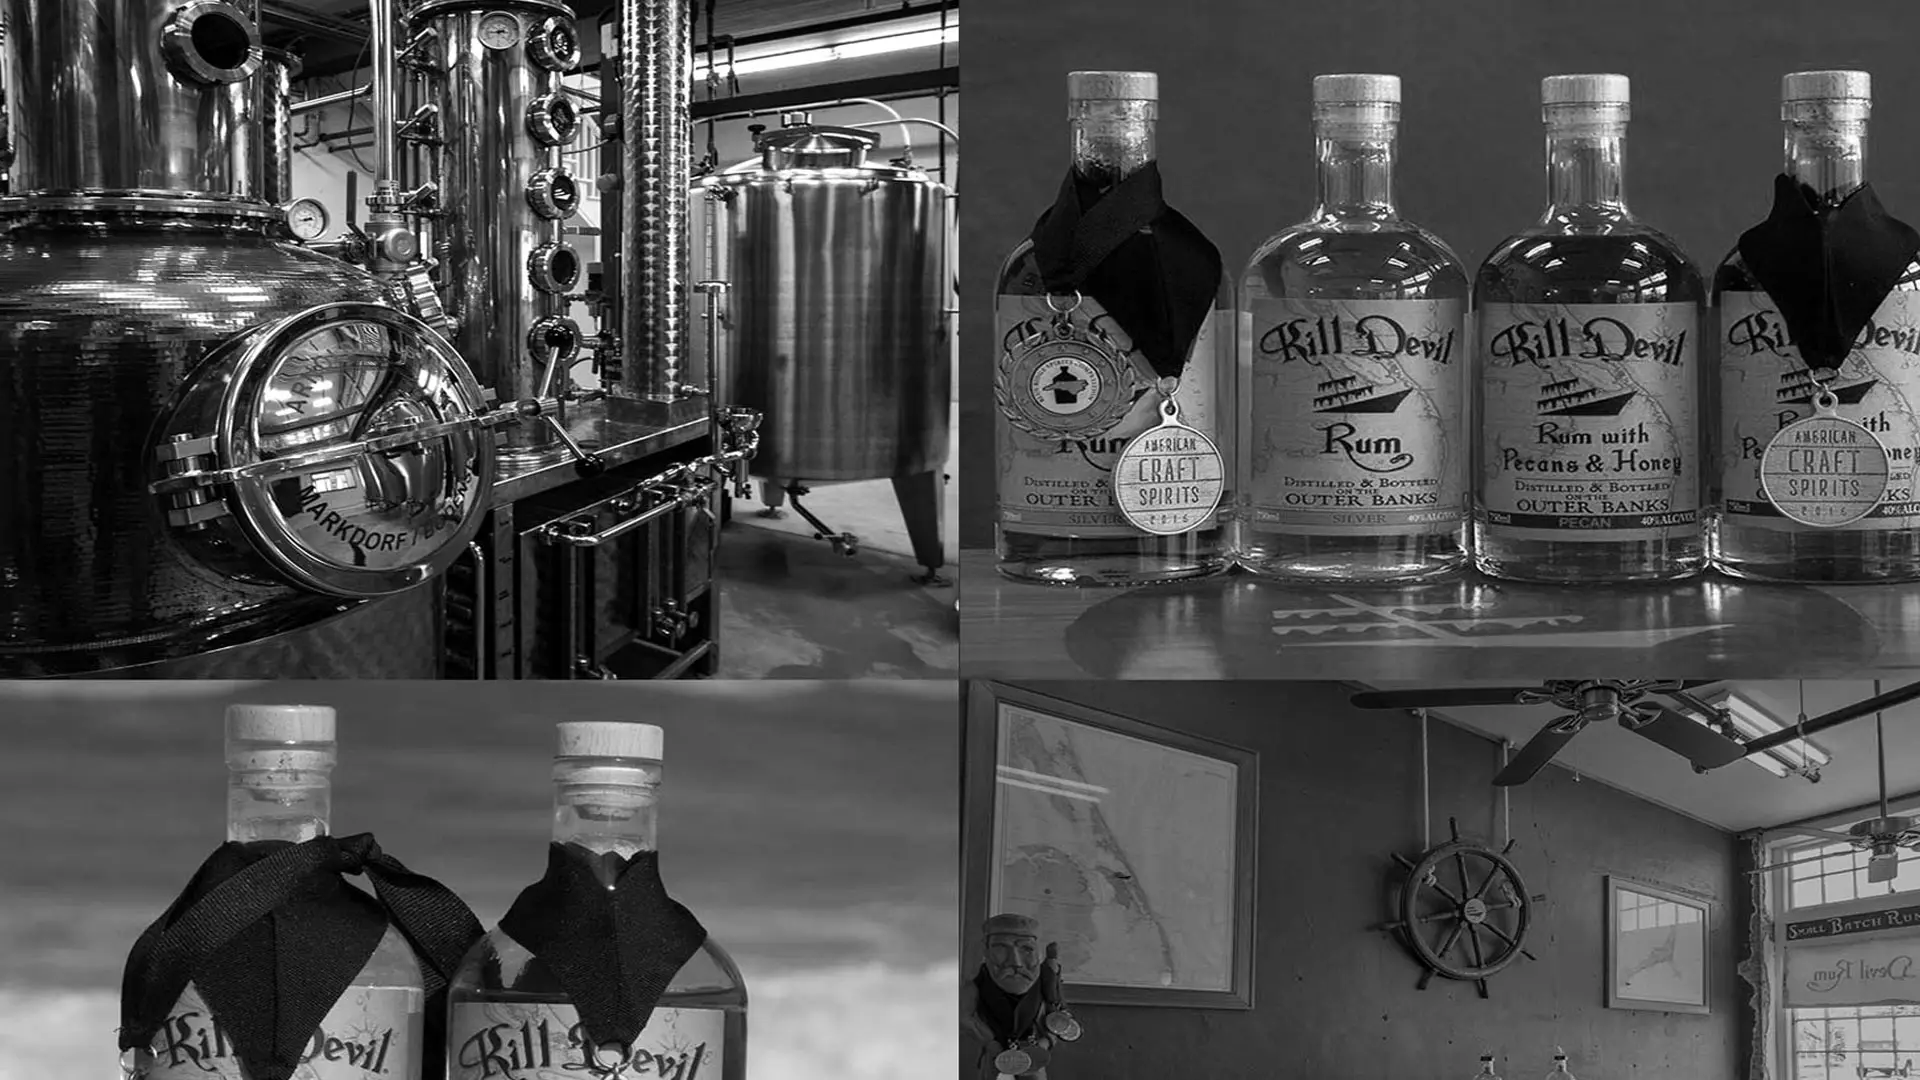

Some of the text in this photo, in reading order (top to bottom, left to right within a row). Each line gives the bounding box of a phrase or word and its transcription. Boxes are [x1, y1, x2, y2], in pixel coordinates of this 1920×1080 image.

[1260, 315, 1454, 366] Kill Devil
[1490, 317, 1687, 369] Kill Devil
[1728, 310, 1790, 357] Ki
[1861, 410, 1890, 432] ith
[1535, 422, 1649, 445] Rum with
[1795, 430, 1856, 444] AMERICAN
[1144, 437, 1197, 453] AMERICAN
[1314, 422, 1414, 473] Rum
[1139, 456, 1200, 483] CRAFT
[1502, 448, 1682, 476] Pecans & Honey
[1788, 450, 1861, 474] CRAFT
[1139, 486, 1200, 505] SPIRITS
[1788, 478, 1860, 497] SPIRITS
[1026, 493, 1100, 507] OUTER
[1285, 492, 1438, 506] OUTER BANKS
[1517, 499, 1670, 514] OUTER BANKS
[299, 485, 407, 551] MARKDORF
[1332, 514, 1387, 524] SILVER
[1559, 517, 1612, 528] PECAN
[1788, 924, 1827, 939] SMALL
[1826, 917, 1882, 934] BATCH
[150, 1012, 240, 1071] Kil
[458, 1018, 551, 1080] Kill
